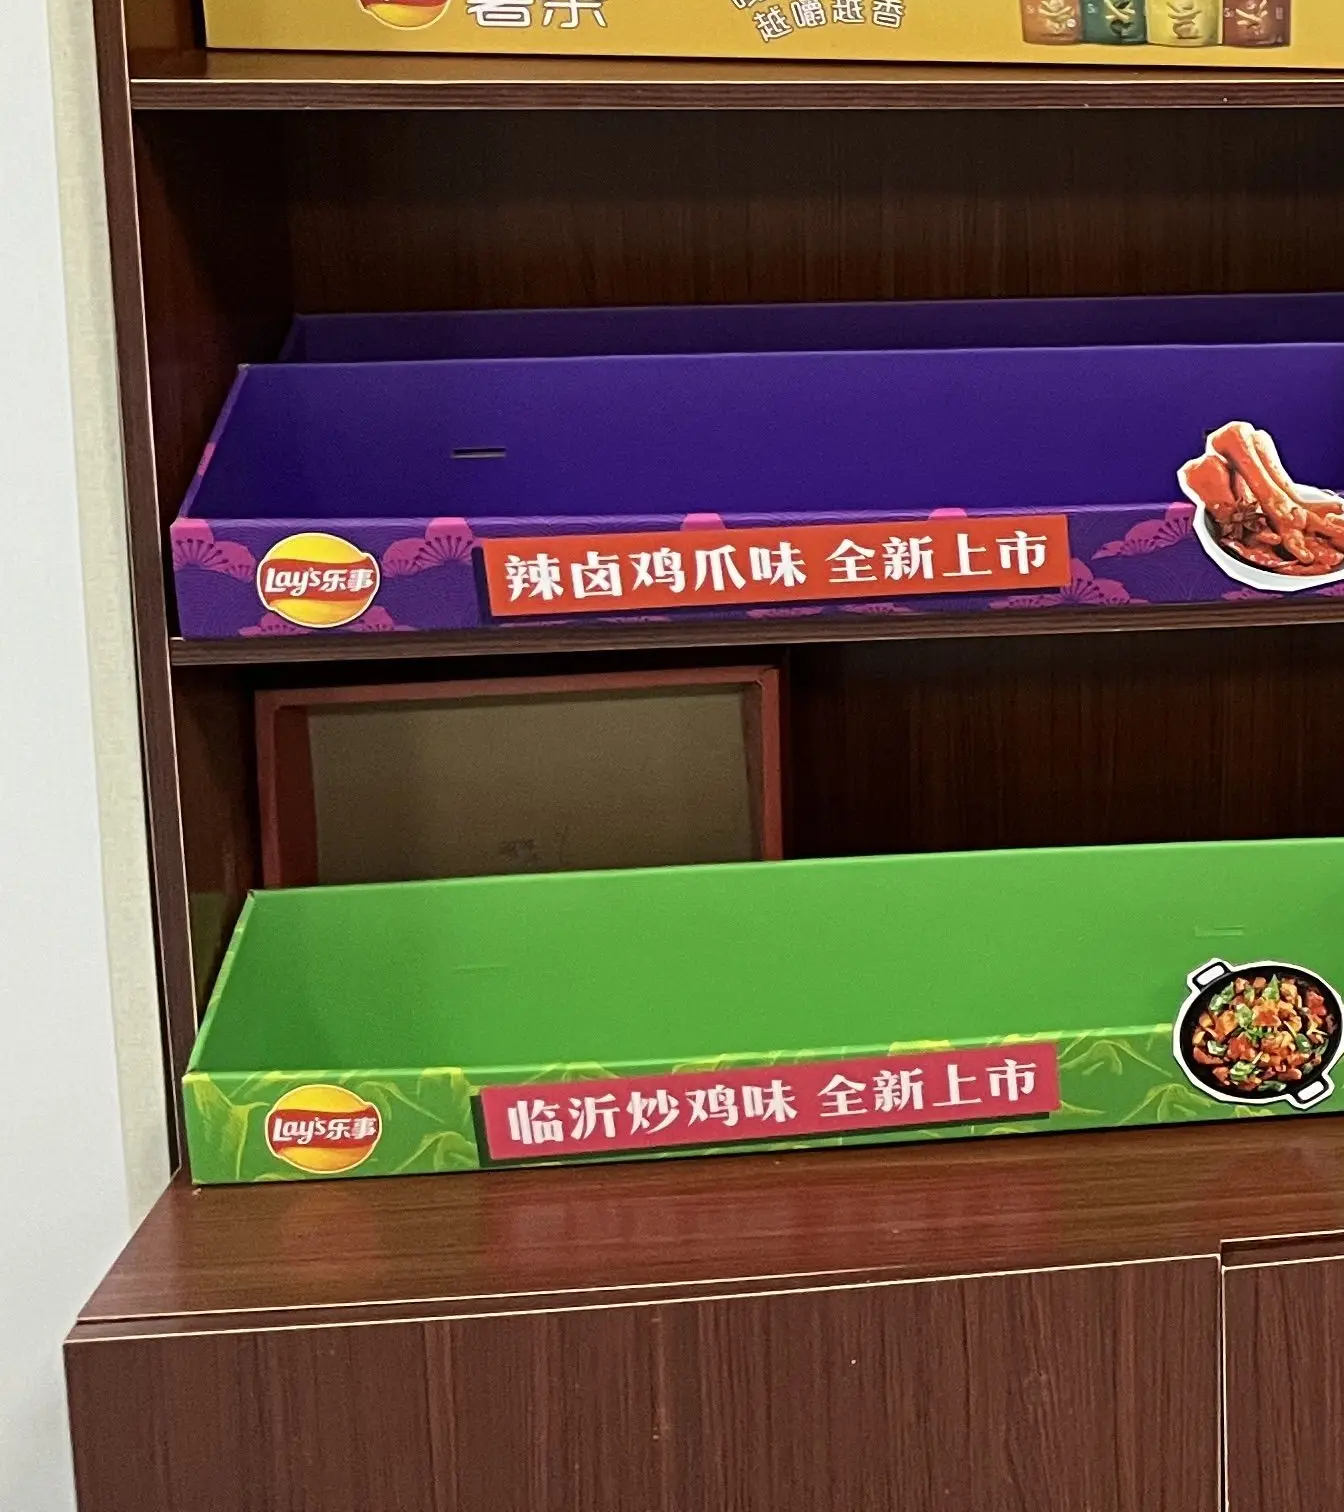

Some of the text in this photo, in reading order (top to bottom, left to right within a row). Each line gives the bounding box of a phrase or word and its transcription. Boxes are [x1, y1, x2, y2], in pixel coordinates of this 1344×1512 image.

[504, 530, 1049, 602] 辣卤鸡爪味 全新上市
[507, 1058, 1037, 1146] 临沂炒鸡味 全新上市
